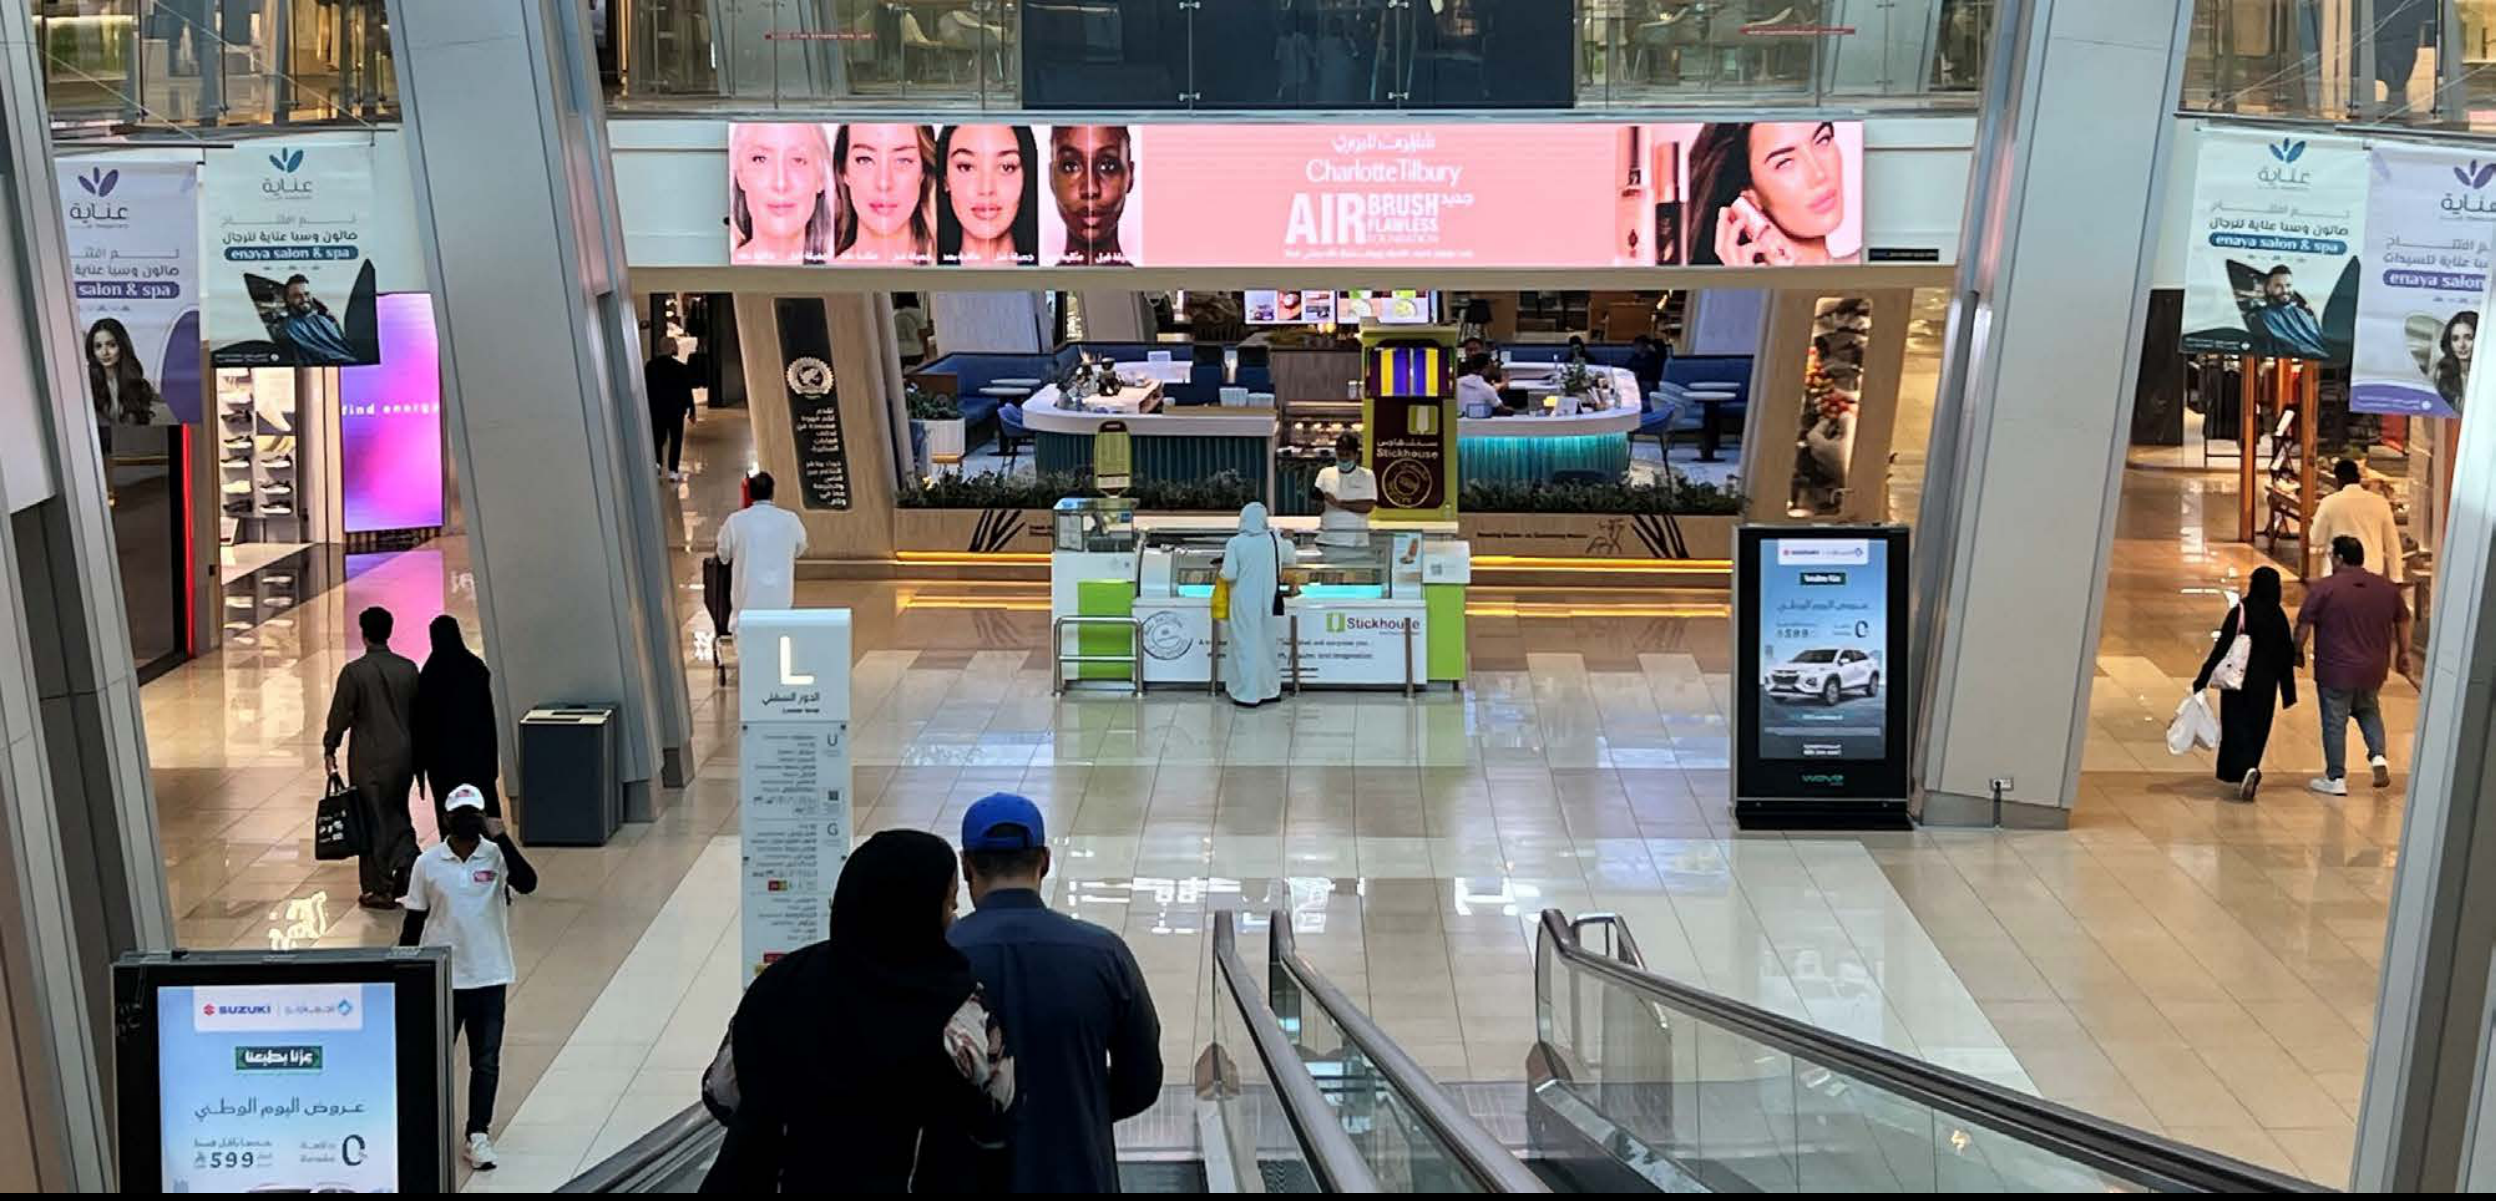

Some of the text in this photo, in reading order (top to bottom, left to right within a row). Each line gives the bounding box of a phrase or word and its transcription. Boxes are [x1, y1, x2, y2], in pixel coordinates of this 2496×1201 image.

[1305, 157, 1464, 187] Charlotte Tilbury
[69, 202, 129, 224] عناية
[1284, 192, 1439, 245] AIR BRUSH
[1368, 218, 1439, 233] FLAWLESS
[2215, 235, 2339, 253] enaya salon & spa
[231, 247, 350, 262] enaya salon & spa
[141, 265, 179, 279] صالون
[2389, 273, 2438, 288] enaya
[78, 282, 172, 299] salon & spa
[341, 402, 376, 417] find
[1376, 447, 1439, 459] Stickhouse
[1346, 617, 1420, 630] Stickhoue
[780, 635, 815, 685] L
[798, 691, 820, 706] الدور
[827, 732, 838, 747] U
[826, 822, 839, 836] G
[218, 1005, 272, 1015] SUZUKI
[260, 1096, 300, 1118] اليوم
[303, 1101, 366, 1117] عروض
[209, 1151, 255, 1169] 599
